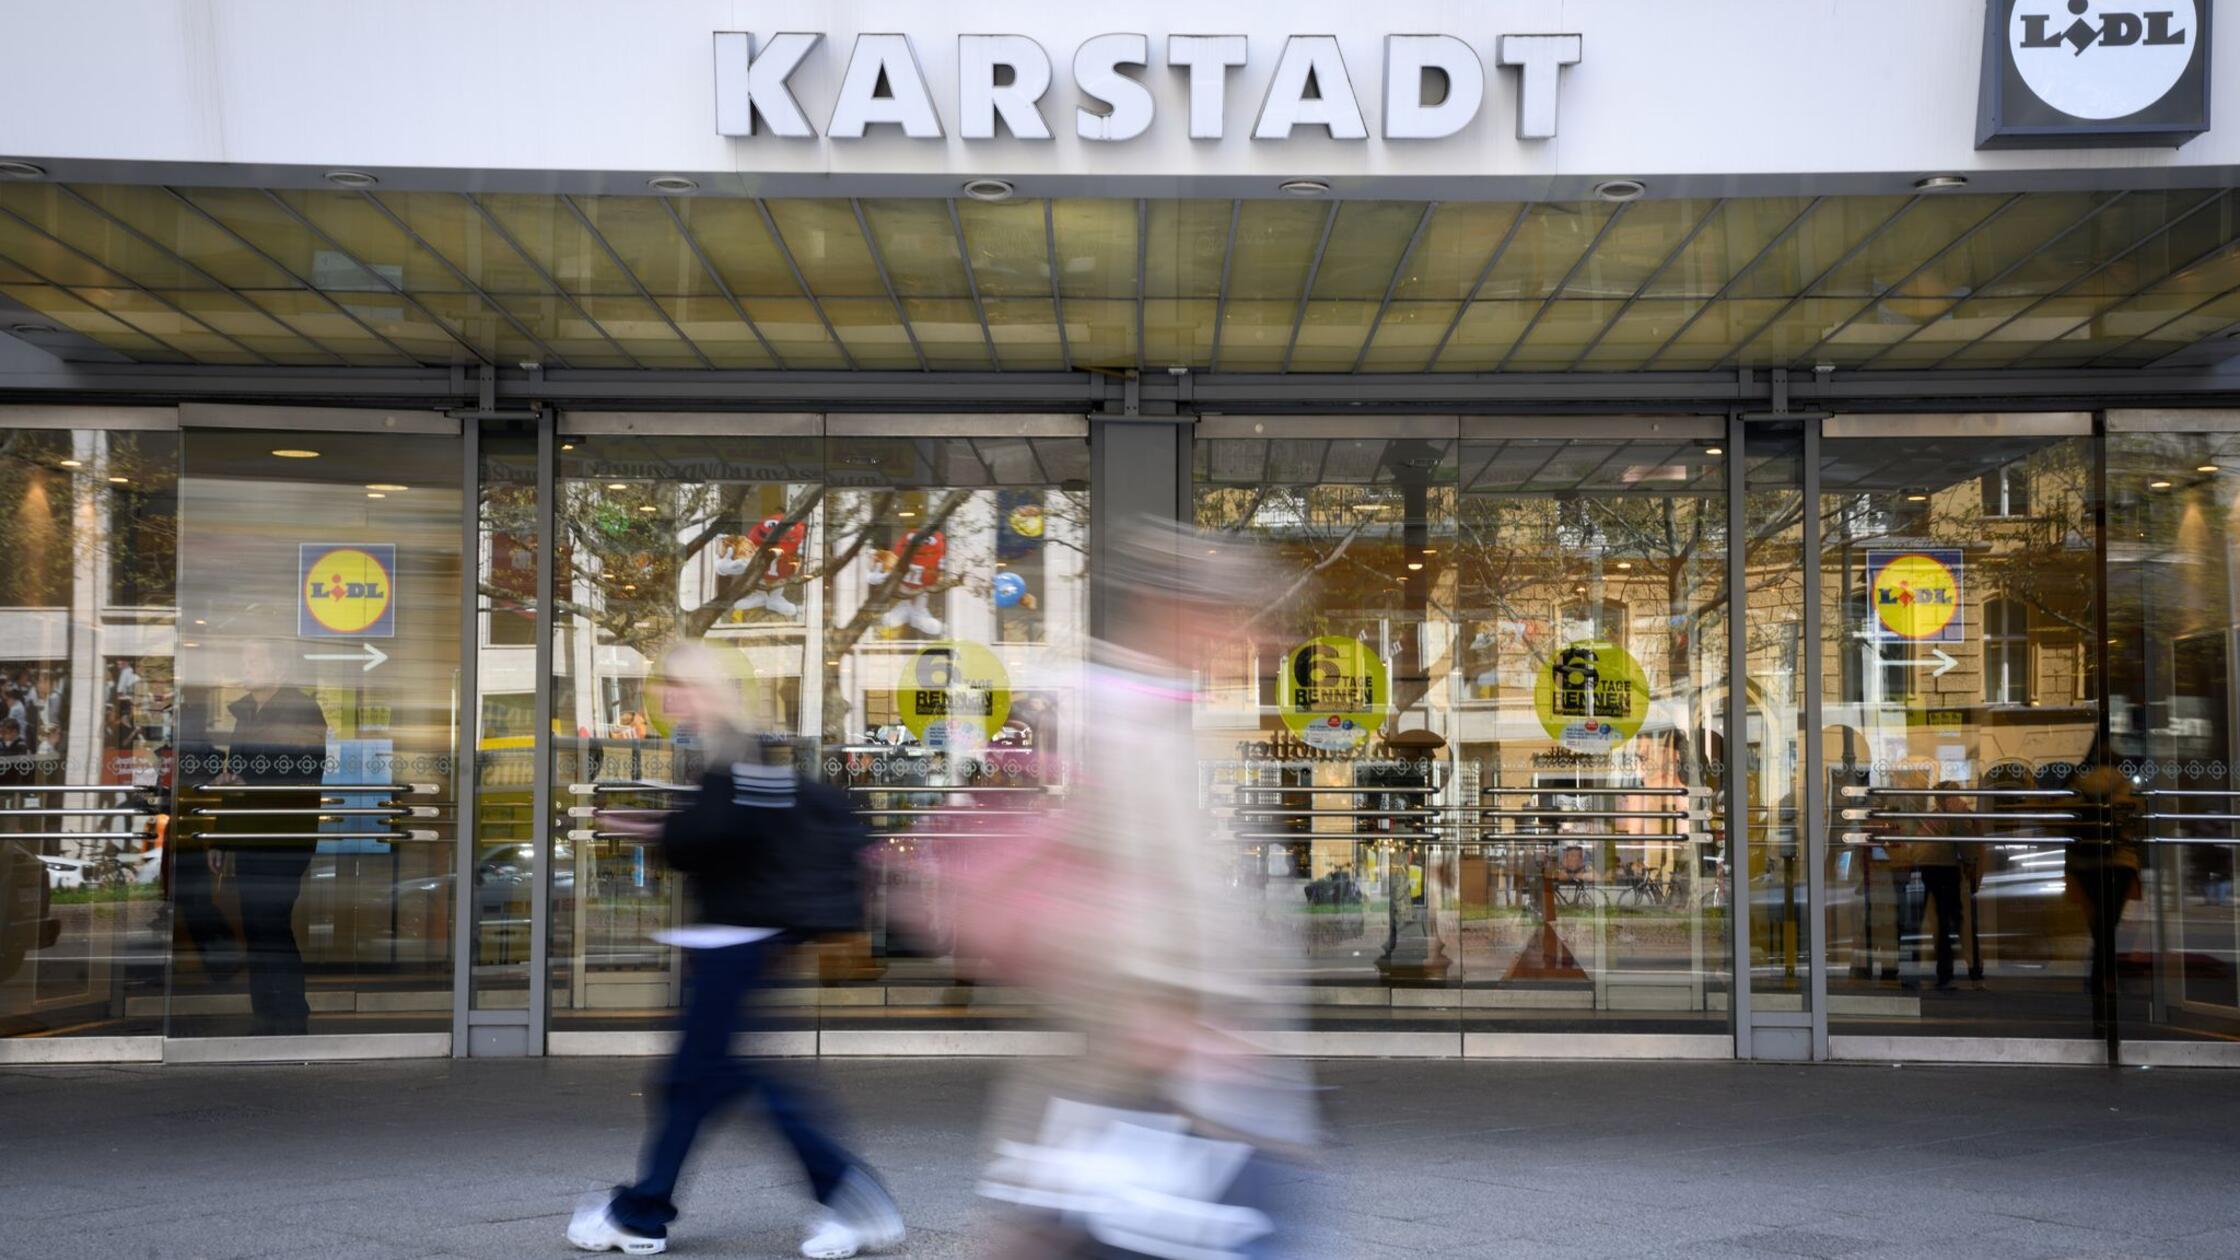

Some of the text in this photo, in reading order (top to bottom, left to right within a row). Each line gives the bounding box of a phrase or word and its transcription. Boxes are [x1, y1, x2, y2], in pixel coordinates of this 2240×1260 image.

[713, 32, 1583, 140] KARSTADT
[1294, 644, 1372, 688] 6 TAGE
[1552, 648, 1631, 692] 6 TAGE
[1295, 688, 1372, 705] RENNEN
